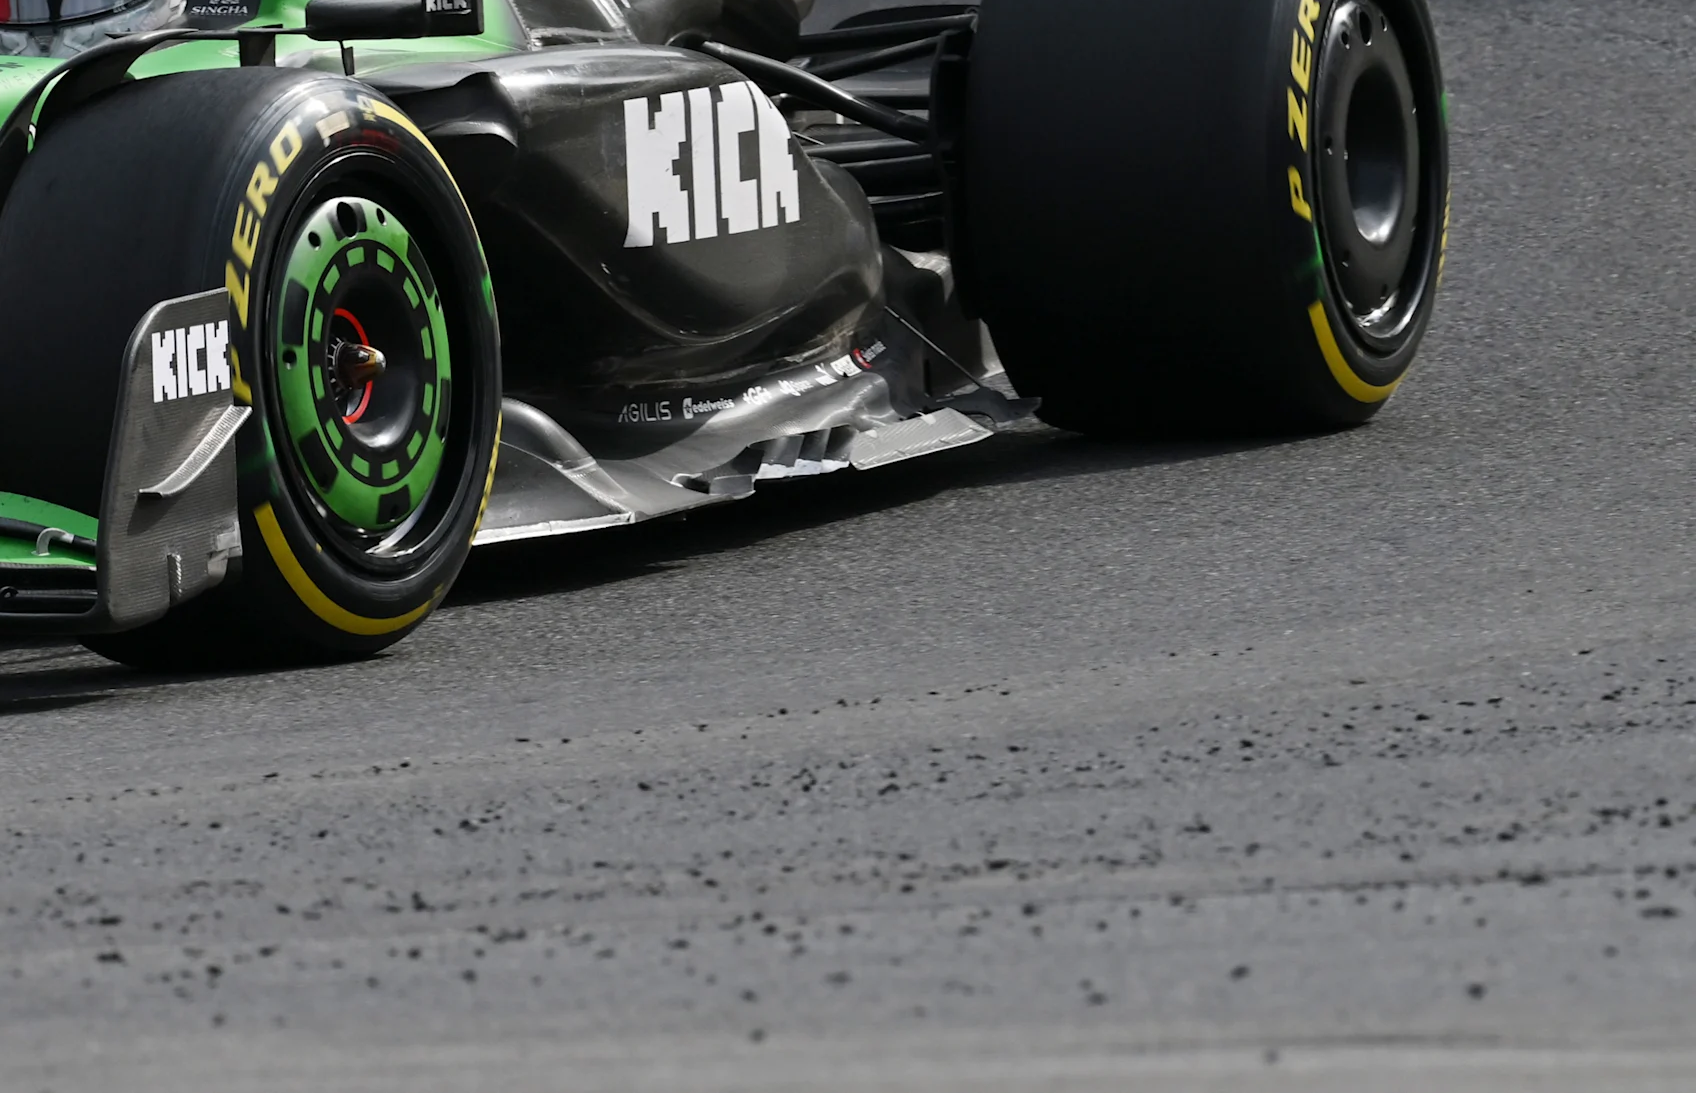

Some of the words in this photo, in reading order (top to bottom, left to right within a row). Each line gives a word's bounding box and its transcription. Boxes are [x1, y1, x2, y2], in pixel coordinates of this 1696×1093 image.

[190, 5, 249, 15] SINGHA
[623, 80, 800, 248] KICK
[1287, 164, 1312, 223] P
[225, 119, 303, 330] ZERO
[151, 319, 232, 403] KICK
[618, 401, 672, 423] AGILIS
[692, 397, 736, 414] edelweiss
